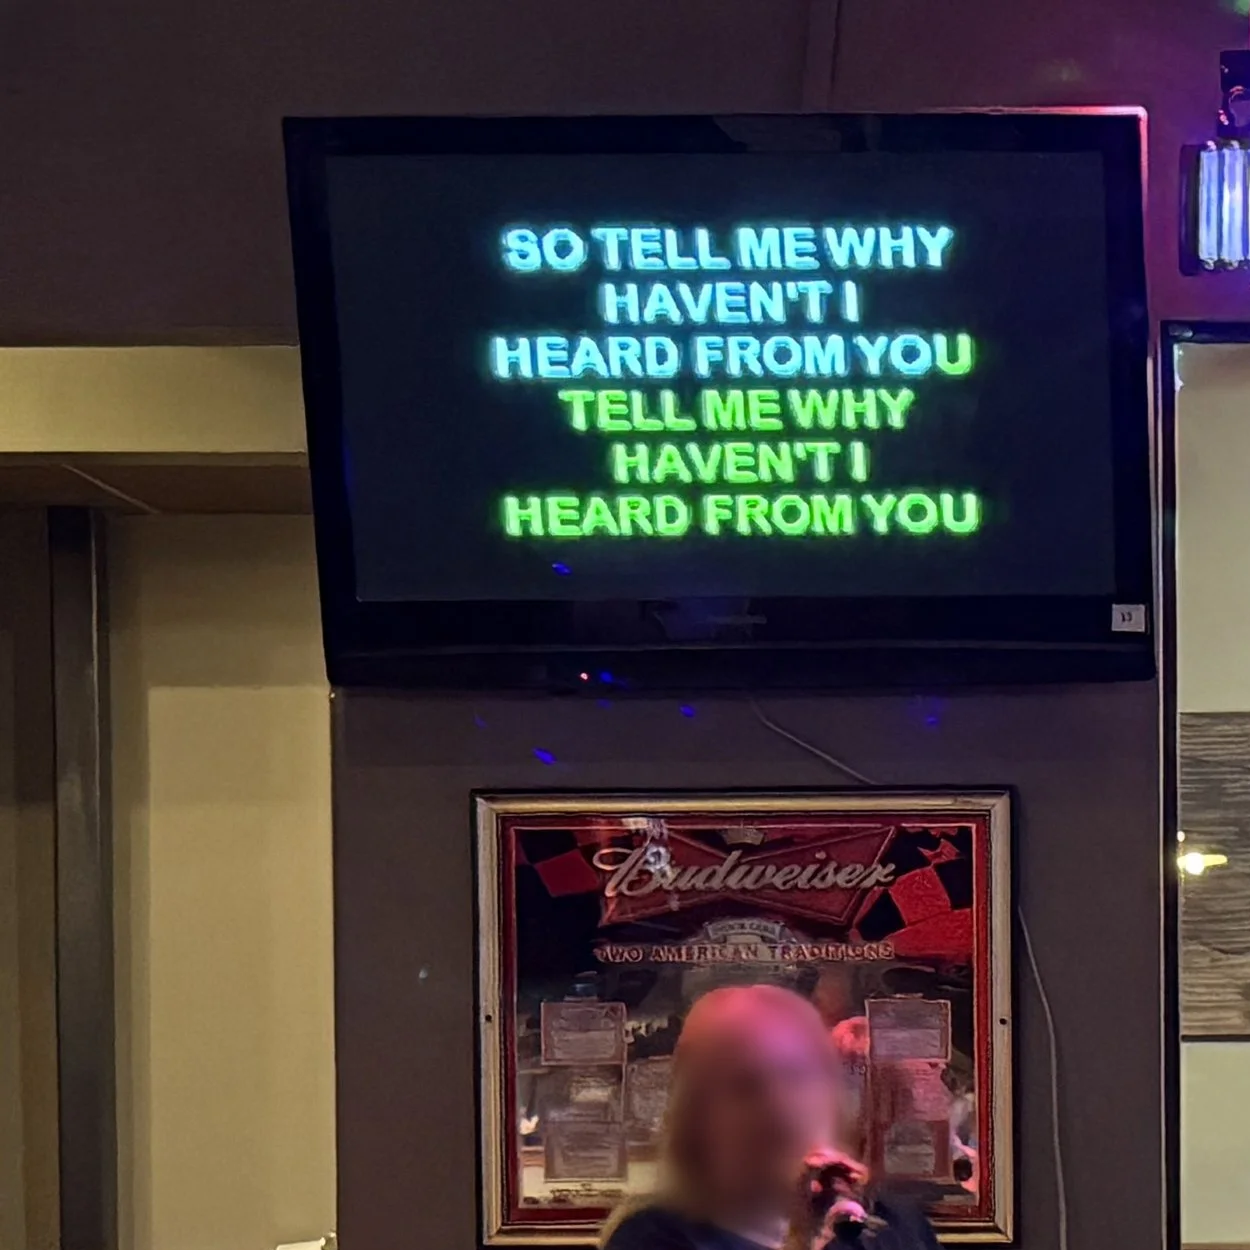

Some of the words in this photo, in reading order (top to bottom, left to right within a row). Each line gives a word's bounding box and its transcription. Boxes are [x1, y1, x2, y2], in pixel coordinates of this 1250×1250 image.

[503, 227, 587, 271] SO
[591, 227, 731, 271] TELL
[736, 227, 820, 270] ME
[822, 226, 954, 269] WHY
[602, 280, 833, 325] HAVEN'T
[842, 280, 860, 323] I
[492, 335, 681, 378] HEARD
[692, 334, 849, 379] FROM
[852, 333, 973, 376] YOU
[558, 389, 696, 431] TELL
[702, 389, 784, 431] ME
[788, 388, 914, 430] WHY
[612, 442, 841, 484] HAVEN'T
[850, 442, 867, 482] I
[504, 495, 692, 537] HEARD
[703, 494, 857, 536] FROM
[861, 493, 979, 533] YOU
[592, 848, 896, 897] Budweiser
[650, 943, 759, 963] AMERICAN
